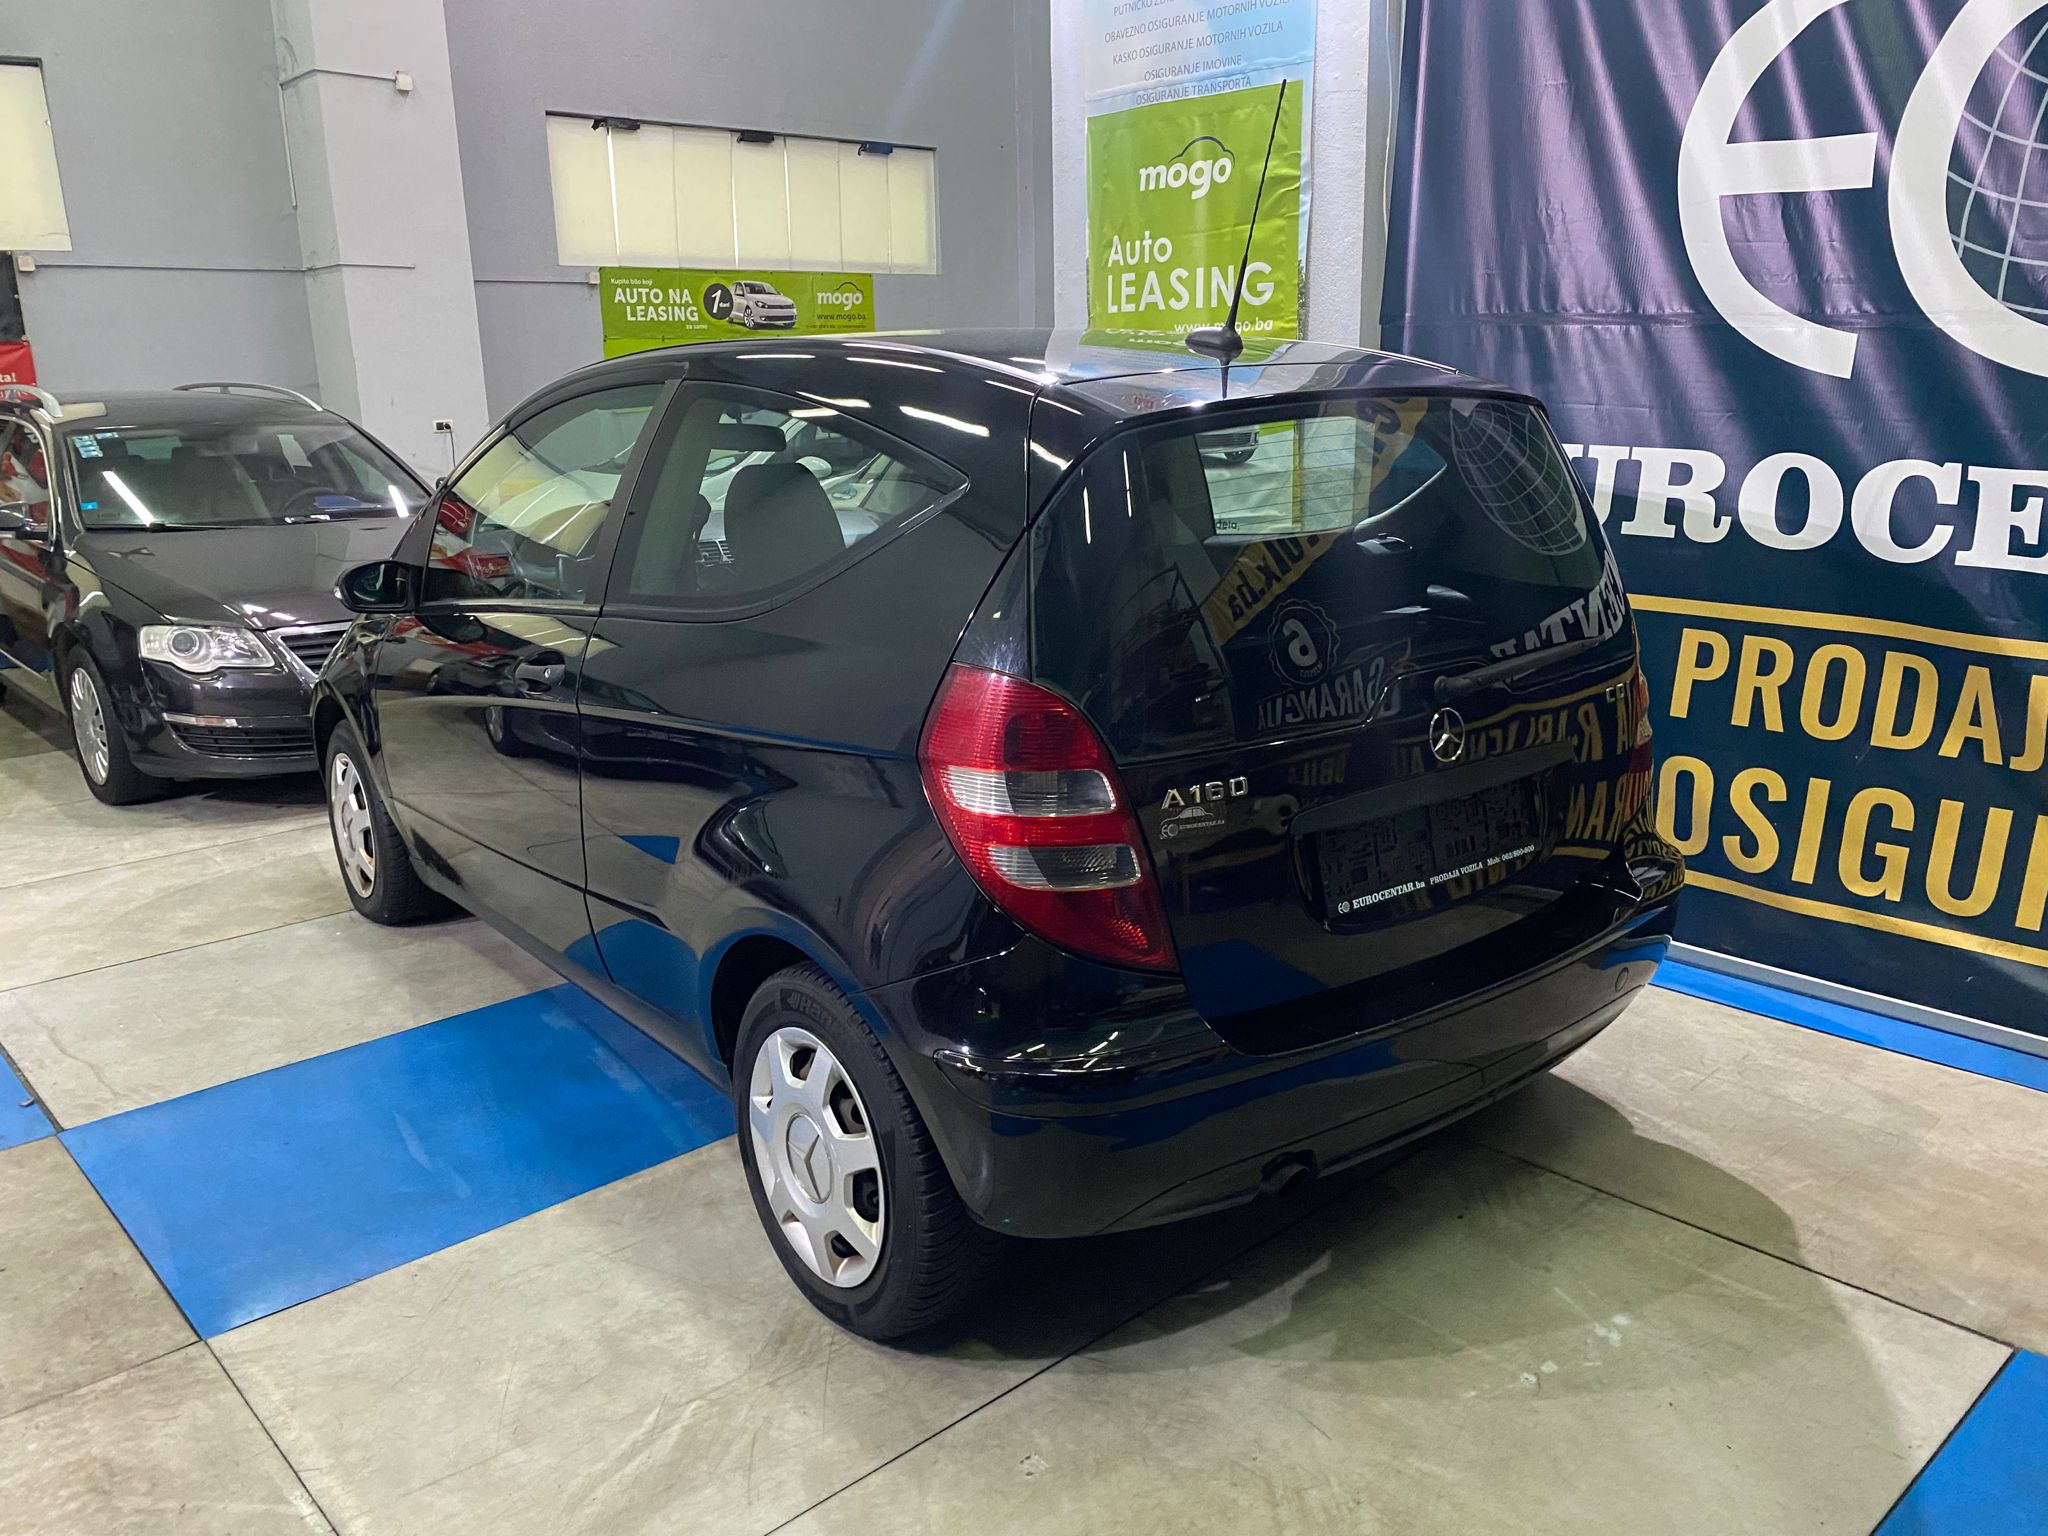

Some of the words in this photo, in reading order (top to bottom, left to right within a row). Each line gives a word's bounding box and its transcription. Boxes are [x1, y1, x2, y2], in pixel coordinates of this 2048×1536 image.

[1104, 22, 1147, 43] OBAVEZNO
[1147, 11, 1204, 32] OSIGURANJE
[1206, 0, 1257, 20] MOTORNIH
[1113, 49, 1138, 65] KASKO
[1138, 38, 1194, 59] OSIGURANJE
[1196, 26, 1247, 48] MOTORNIH
[1248, 20, 1284, 38] VOZILA
[1144, 61, 1200, 81] OSIGURANJE
[1202, 55, 1242, 72] IMOVINE
[1136, 86, 1190, 105] OSIGURANJE
[1192, 76, 1252, 97] TRANSPORTA
[1139, 157, 1232, 200] mogo
[1107, 230, 1173, 267] Auto
[614, 288, 663, 304] AUTO
[669, 289, 693, 304] NA
[711, 289, 722, 314] 1
[817, 292, 863, 311] mogo
[1107, 262, 1275, 314] LEASING
[626, 306, 699, 321] LEASING
[816, 313, 866, 322] www.mogo.ba
[1352, 880, 1426, 909] EUROCENTAR.ba
[1429, 869, 1460, 885] PRODAJA
[1460, 861, 1484, 876] VOZILA
